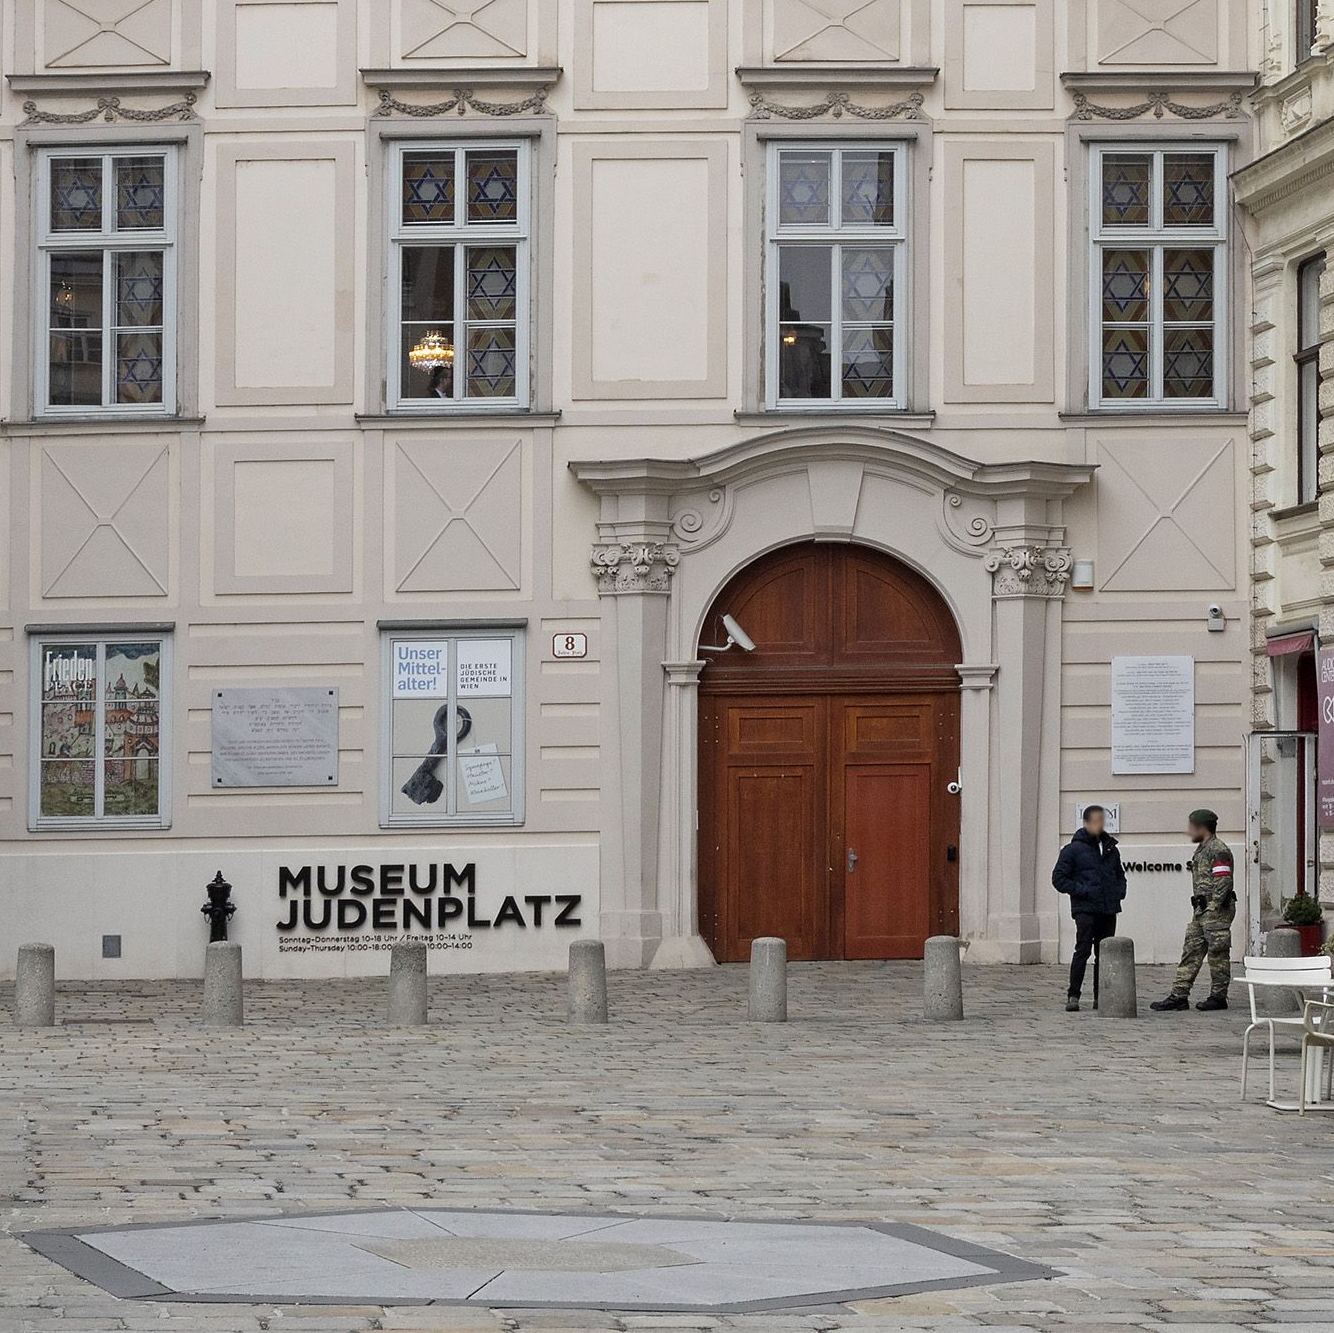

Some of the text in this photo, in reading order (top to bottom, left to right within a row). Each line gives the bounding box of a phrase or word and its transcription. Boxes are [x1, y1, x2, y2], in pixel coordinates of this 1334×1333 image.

[565, 636, 575, 651] 8
[398, 646, 443, 661] Unser
[46, 650, 93, 682] Frieden
[398, 661, 447, 676] Mittel-
[475, 662, 498, 670] ERSTE
[398, 676, 437, 691] alter!
[1123, 860, 1183, 873] Welcome
[278, 863, 476, 897] MUSEUM
[275, 894, 582, 930] JUDENPLATZ
[279, 935, 360, 945] Sonntag-Donnerstag
[361, 935, 382, 943] 10-18
[383, 934, 398, 942] Uhr
[406, 933, 434, 942] Freitag
[435, 933, 456, 941] 10-14
[458, 933, 473, 941] Uhr
[279, 944, 346, 954] Sunday-Thursday
